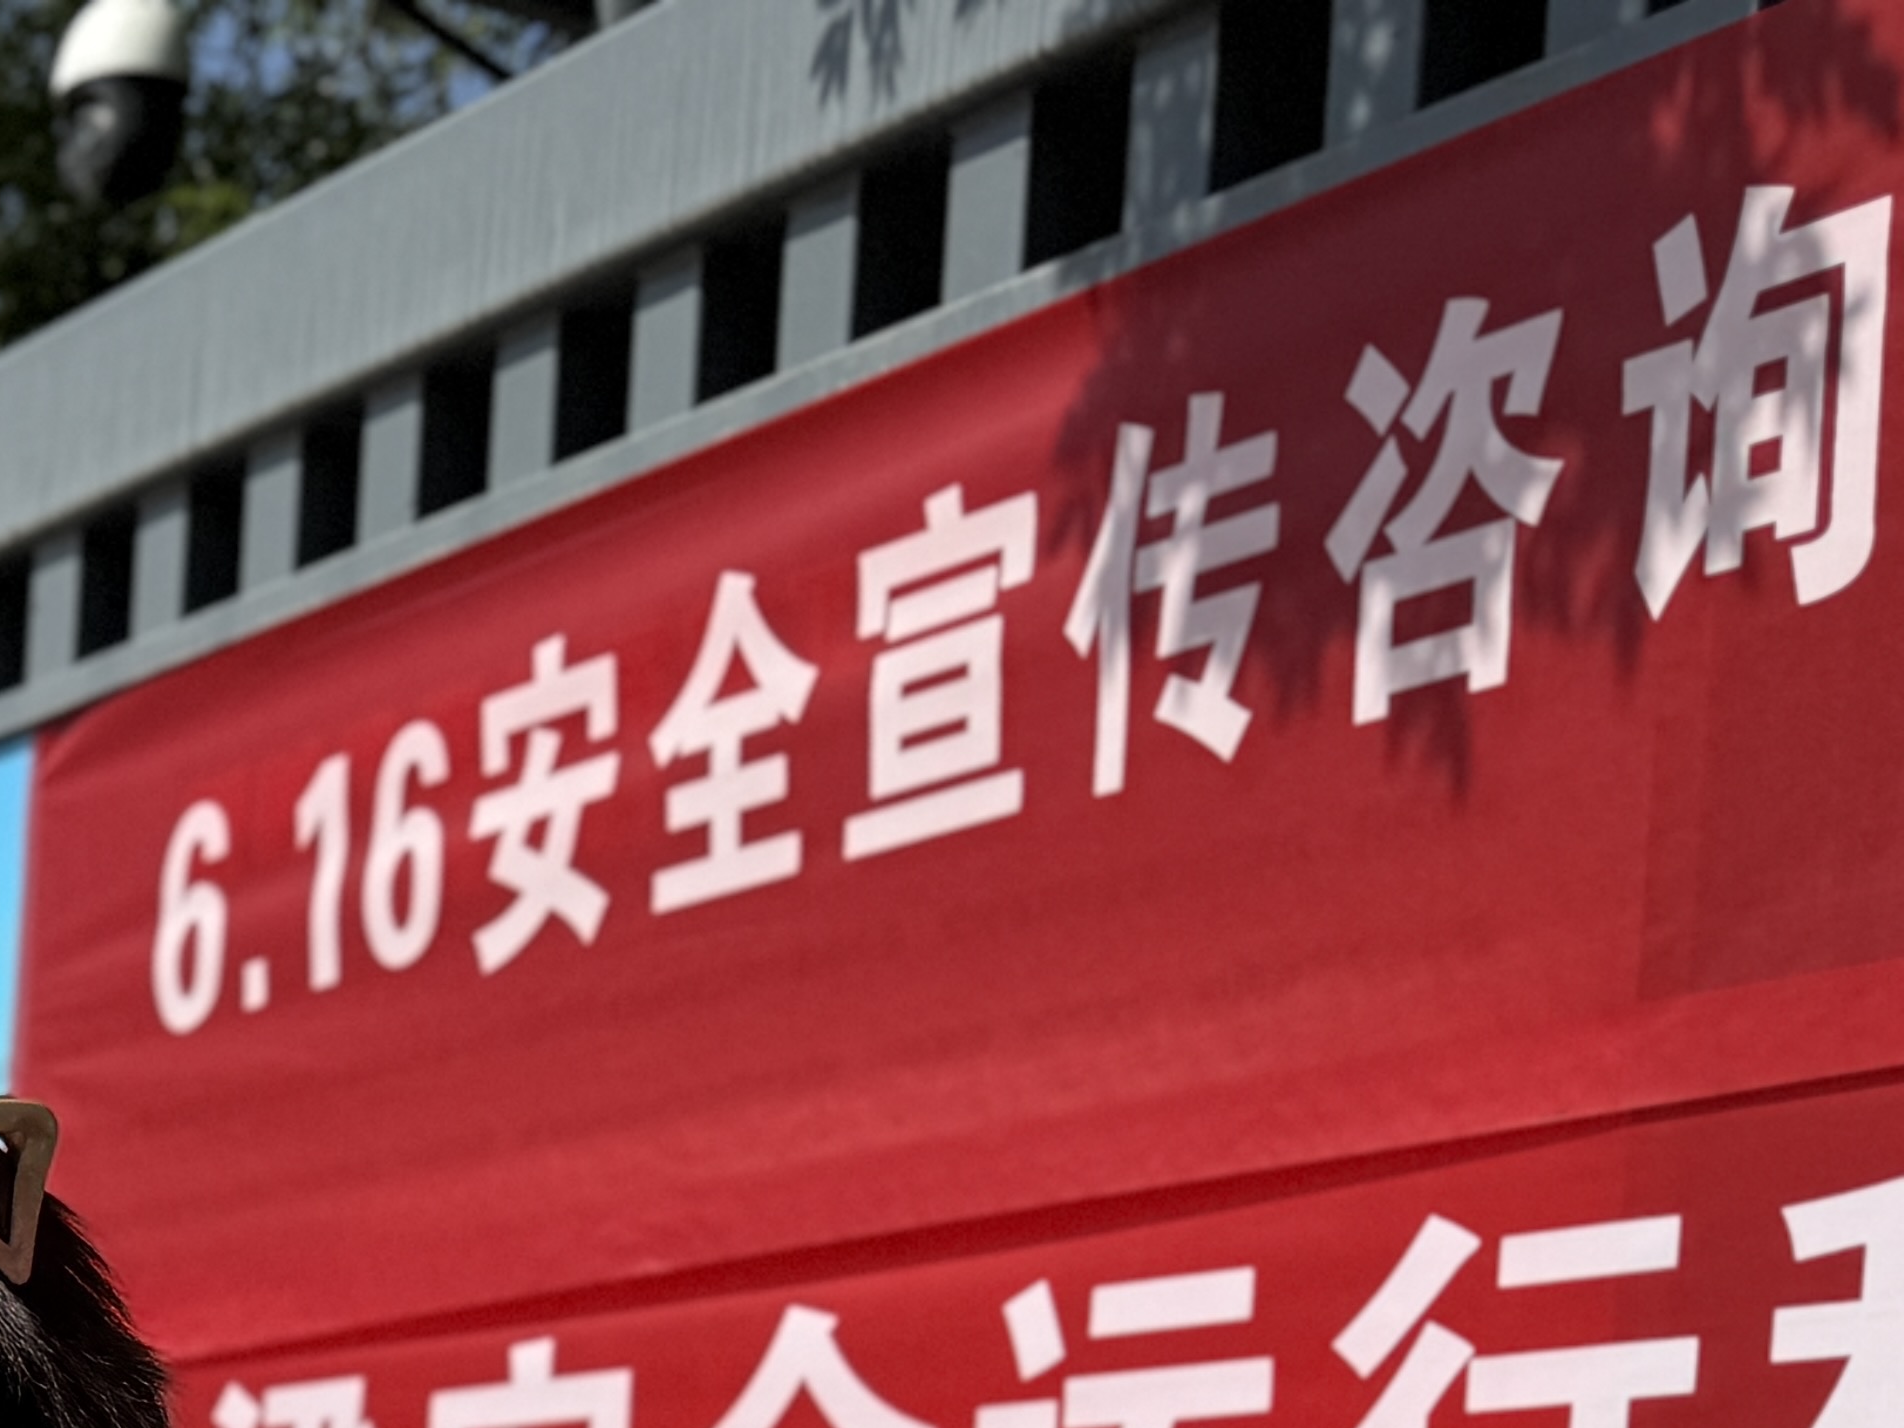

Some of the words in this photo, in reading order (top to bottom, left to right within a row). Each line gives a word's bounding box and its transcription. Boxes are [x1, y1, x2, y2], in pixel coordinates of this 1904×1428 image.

[150, 182, 1896, 1035] 6.16安全宣传咨询
